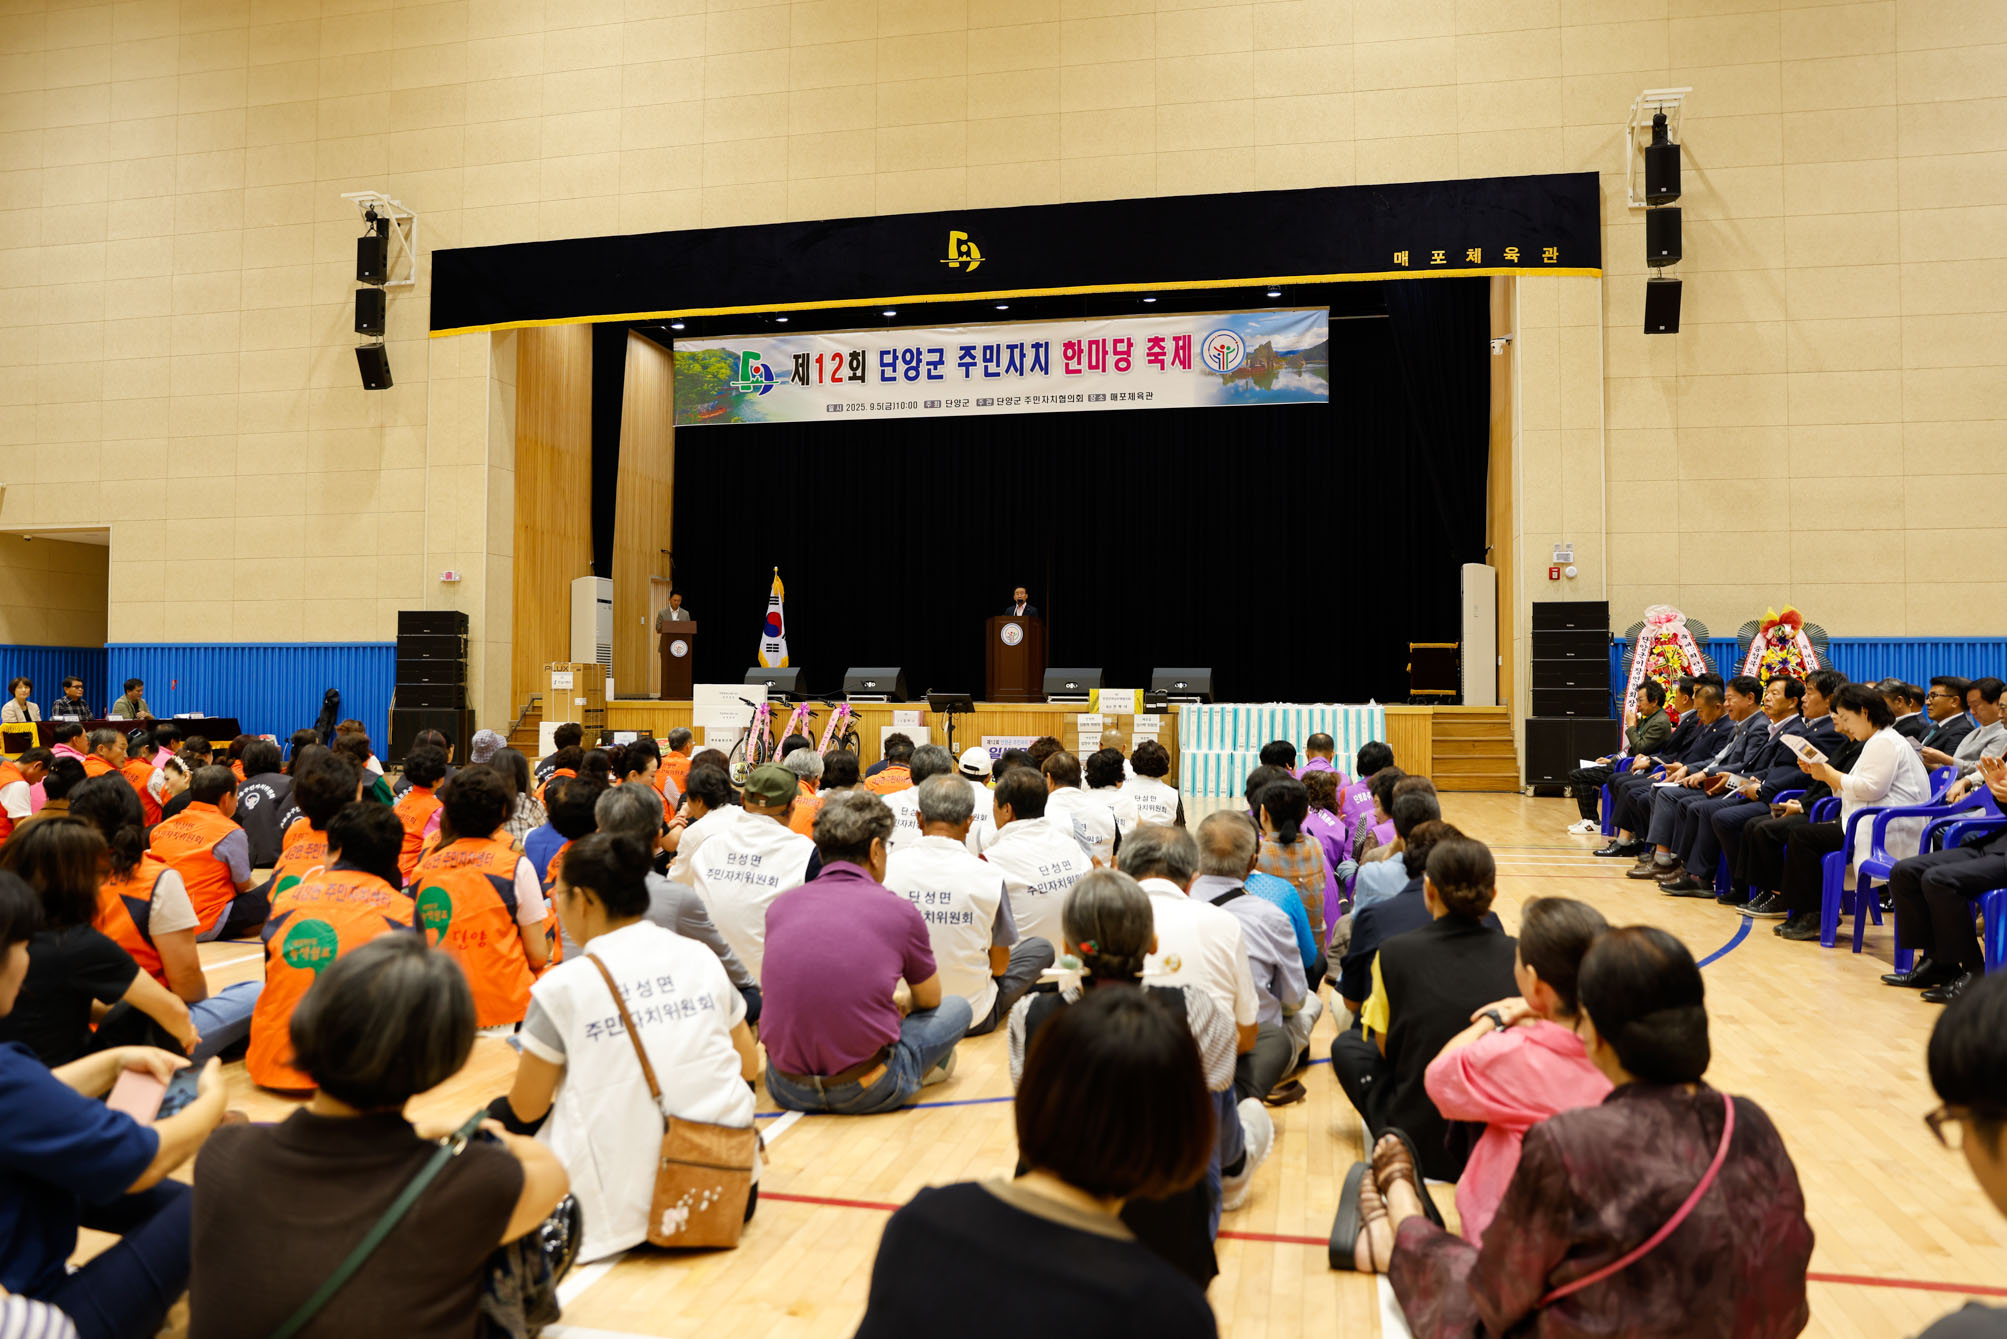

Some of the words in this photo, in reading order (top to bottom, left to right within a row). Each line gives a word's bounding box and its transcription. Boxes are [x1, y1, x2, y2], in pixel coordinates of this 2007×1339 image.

[791, 349, 866, 386] 제12회
[879, 347, 945, 382] 단양군
[957, 340, 1049, 379] 주민자치
[1062, 336, 1134, 375] 한마당
[1145, 334, 1192, 371] 축제
[945, 399, 970, 408] 단양군
[996, 396, 1021, 406] 단양군
[1024, 394, 1084, 405] 주민자치협의회
[1110, 391, 1154, 402] 매포체육관
[727, 853, 762, 868] 단성면
[1038, 860, 1072, 877] 단성면
[705, 868, 779, 888] 주민자치위원회
[909, 890, 952, 905] 단성면
